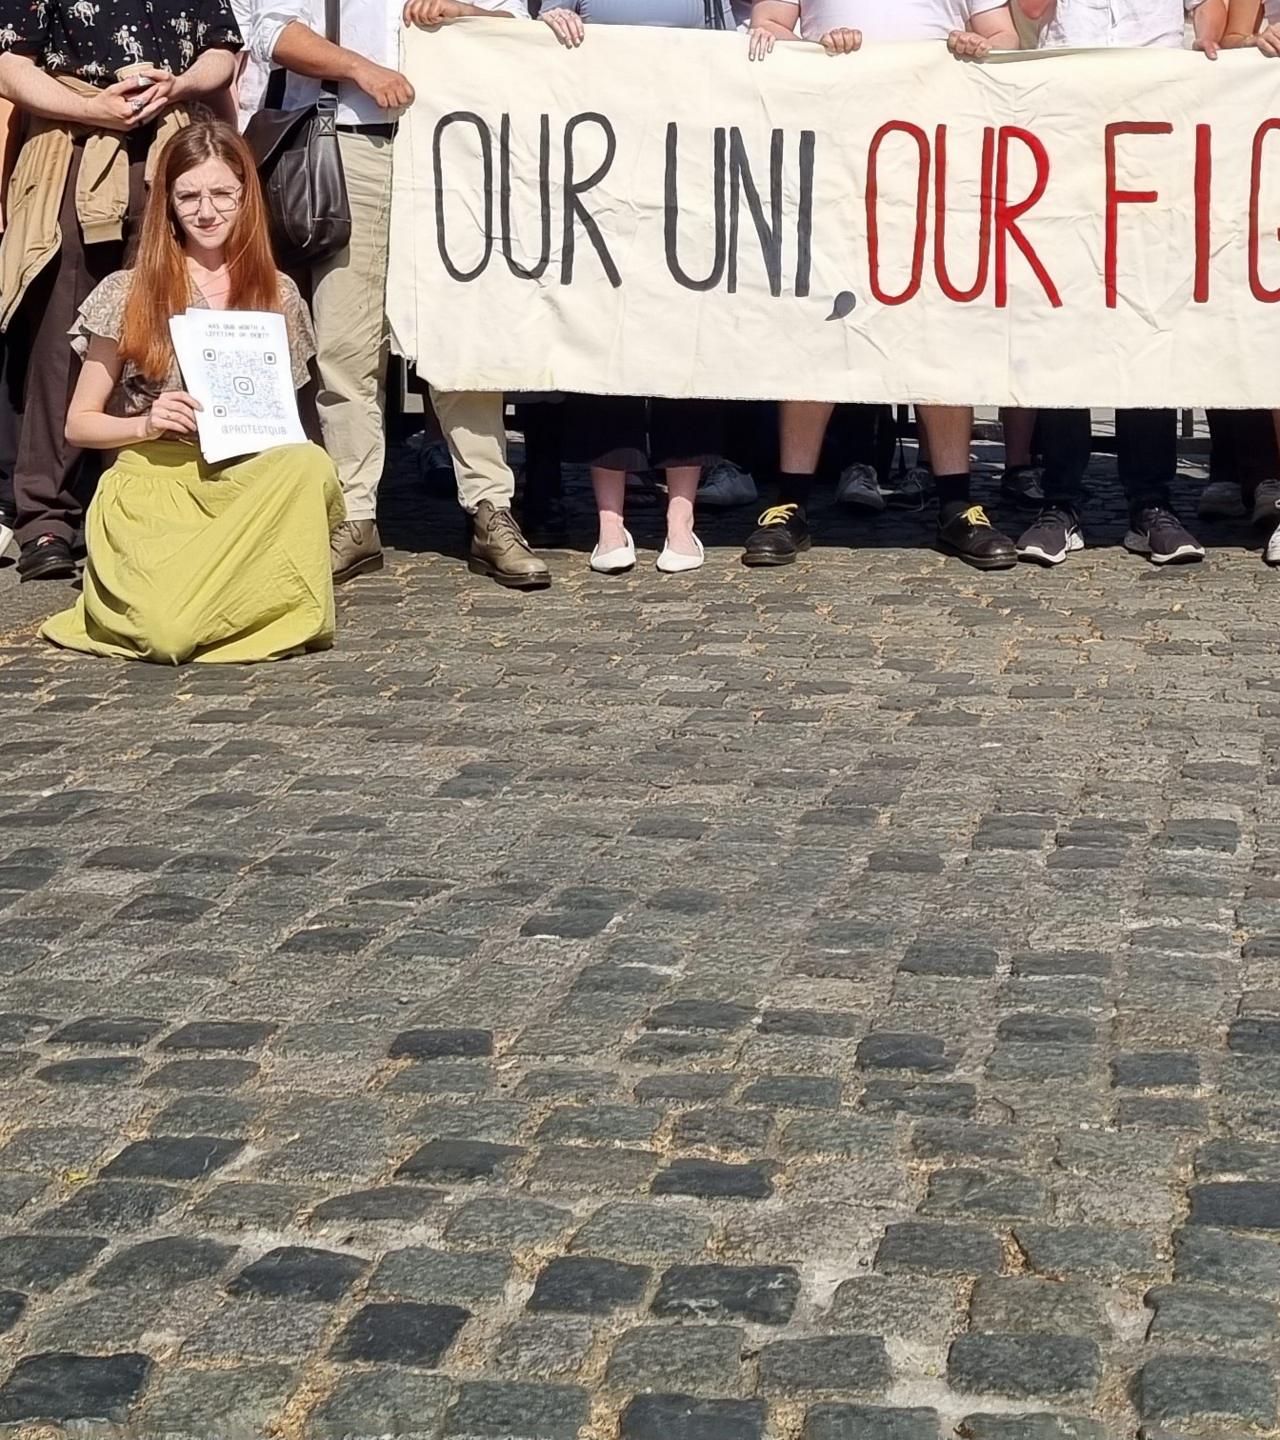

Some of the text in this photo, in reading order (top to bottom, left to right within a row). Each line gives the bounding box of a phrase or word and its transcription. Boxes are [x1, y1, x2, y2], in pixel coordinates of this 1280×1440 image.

[433, 111, 622, 288] OUR
[664, 122, 856, 321] UNI,
[865, 120, 1063, 308] OUR
